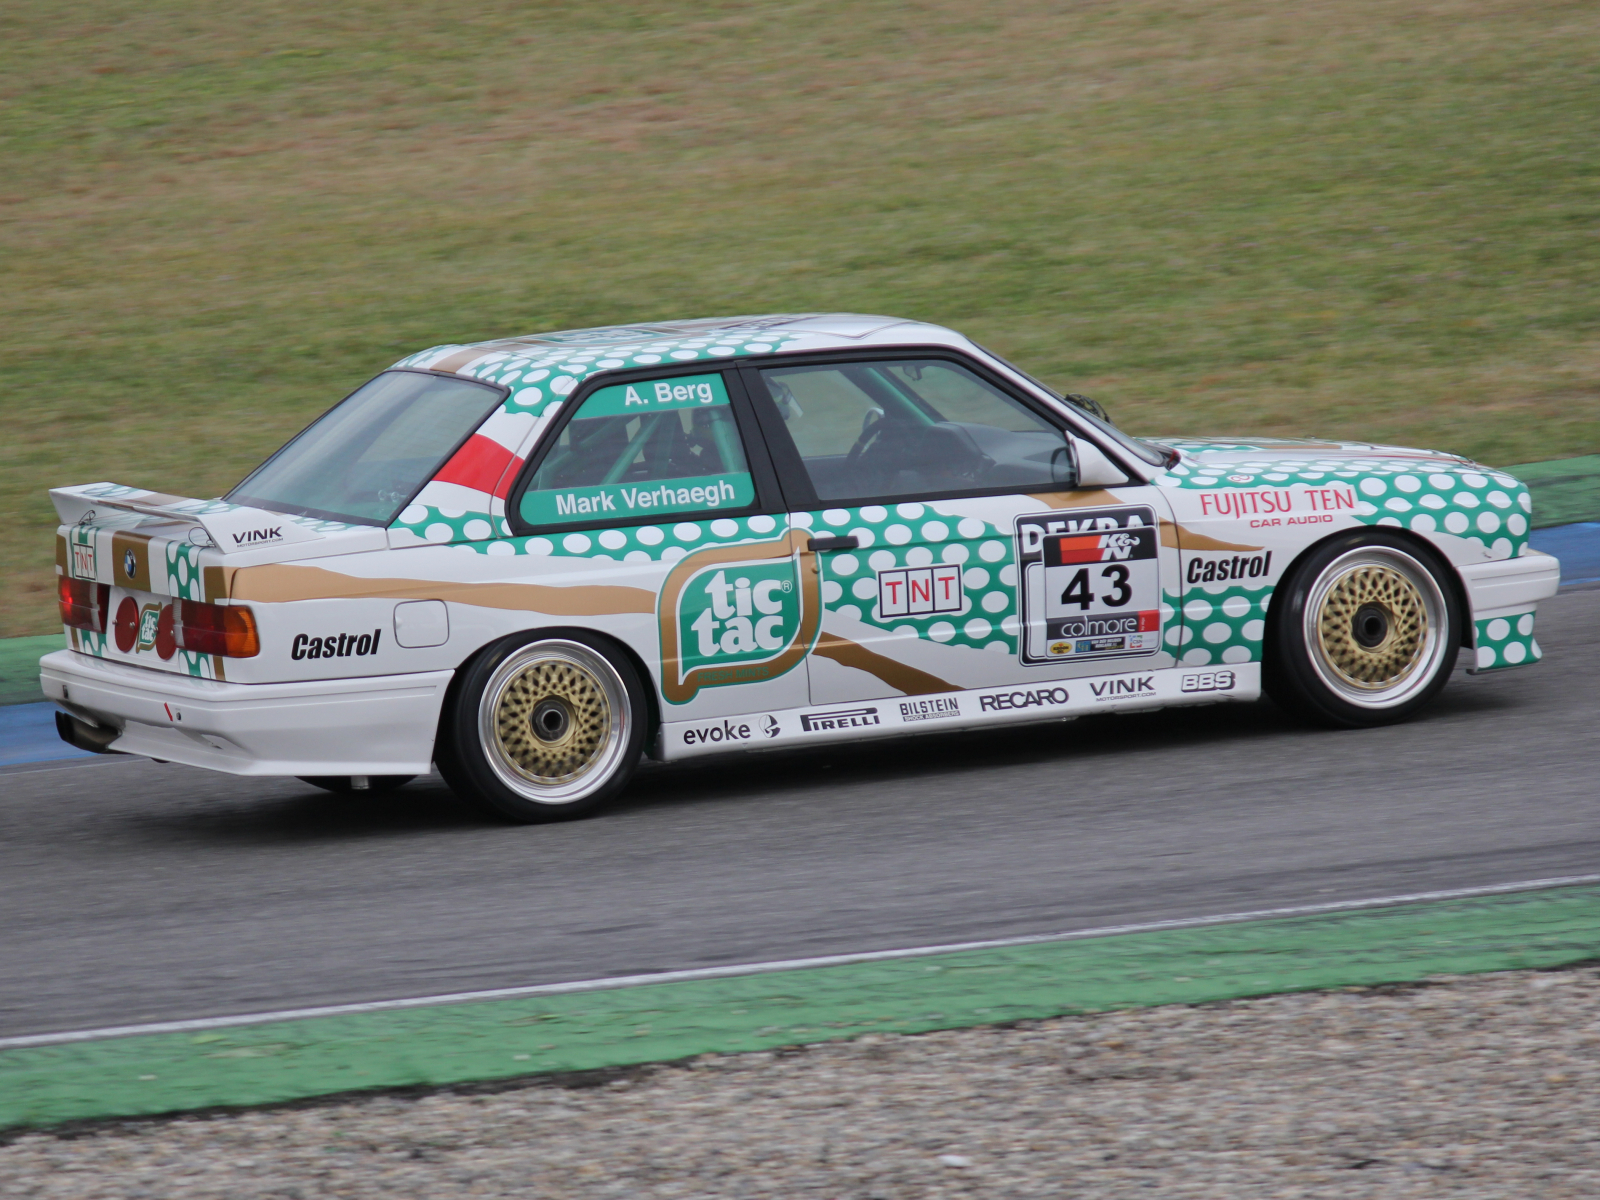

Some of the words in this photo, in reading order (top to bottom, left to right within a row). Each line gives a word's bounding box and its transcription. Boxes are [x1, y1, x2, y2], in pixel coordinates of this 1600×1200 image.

[624, 386, 649, 406] A.
[654, 382, 713, 403] Berg
[555, 491, 615, 515] Mark
[621, 480, 735, 509] Verhaegh
[1199, 490, 1292, 519] FUJITSU
[1304, 489, 1355, 511] TEN
[1250, 518, 1282, 529] CAR
[1287, 514, 1333, 526] AUDIO
[232, 526, 282, 544] VINK
[74, 551, 94, 572] TNT
[1187, 550, 1272, 584] Castrol
[704, 570, 784, 621] tic
[885, 575, 956, 605] TNT
[1061, 563, 1133, 611] 43
[691, 607, 784, 657] tac
[1061, 615, 1137, 637] colmore
[291, 628, 382, 661] Castrol
[697, 668, 734, 683] FRESH
[736, 665, 770, 680] MINTS
[1180, 671, 1236, 693] BBS
[979, 687, 1069, 712] RECARO
[1089, 676, 1155, 698] VINK
[1095, 691, 1157, 702] MOTORSPORT.COM
[900, 697, 959, 716] BILSTEIN
[800, 707, 881, 732] PIRELLI
[683, 720, 751, 745] evoke
